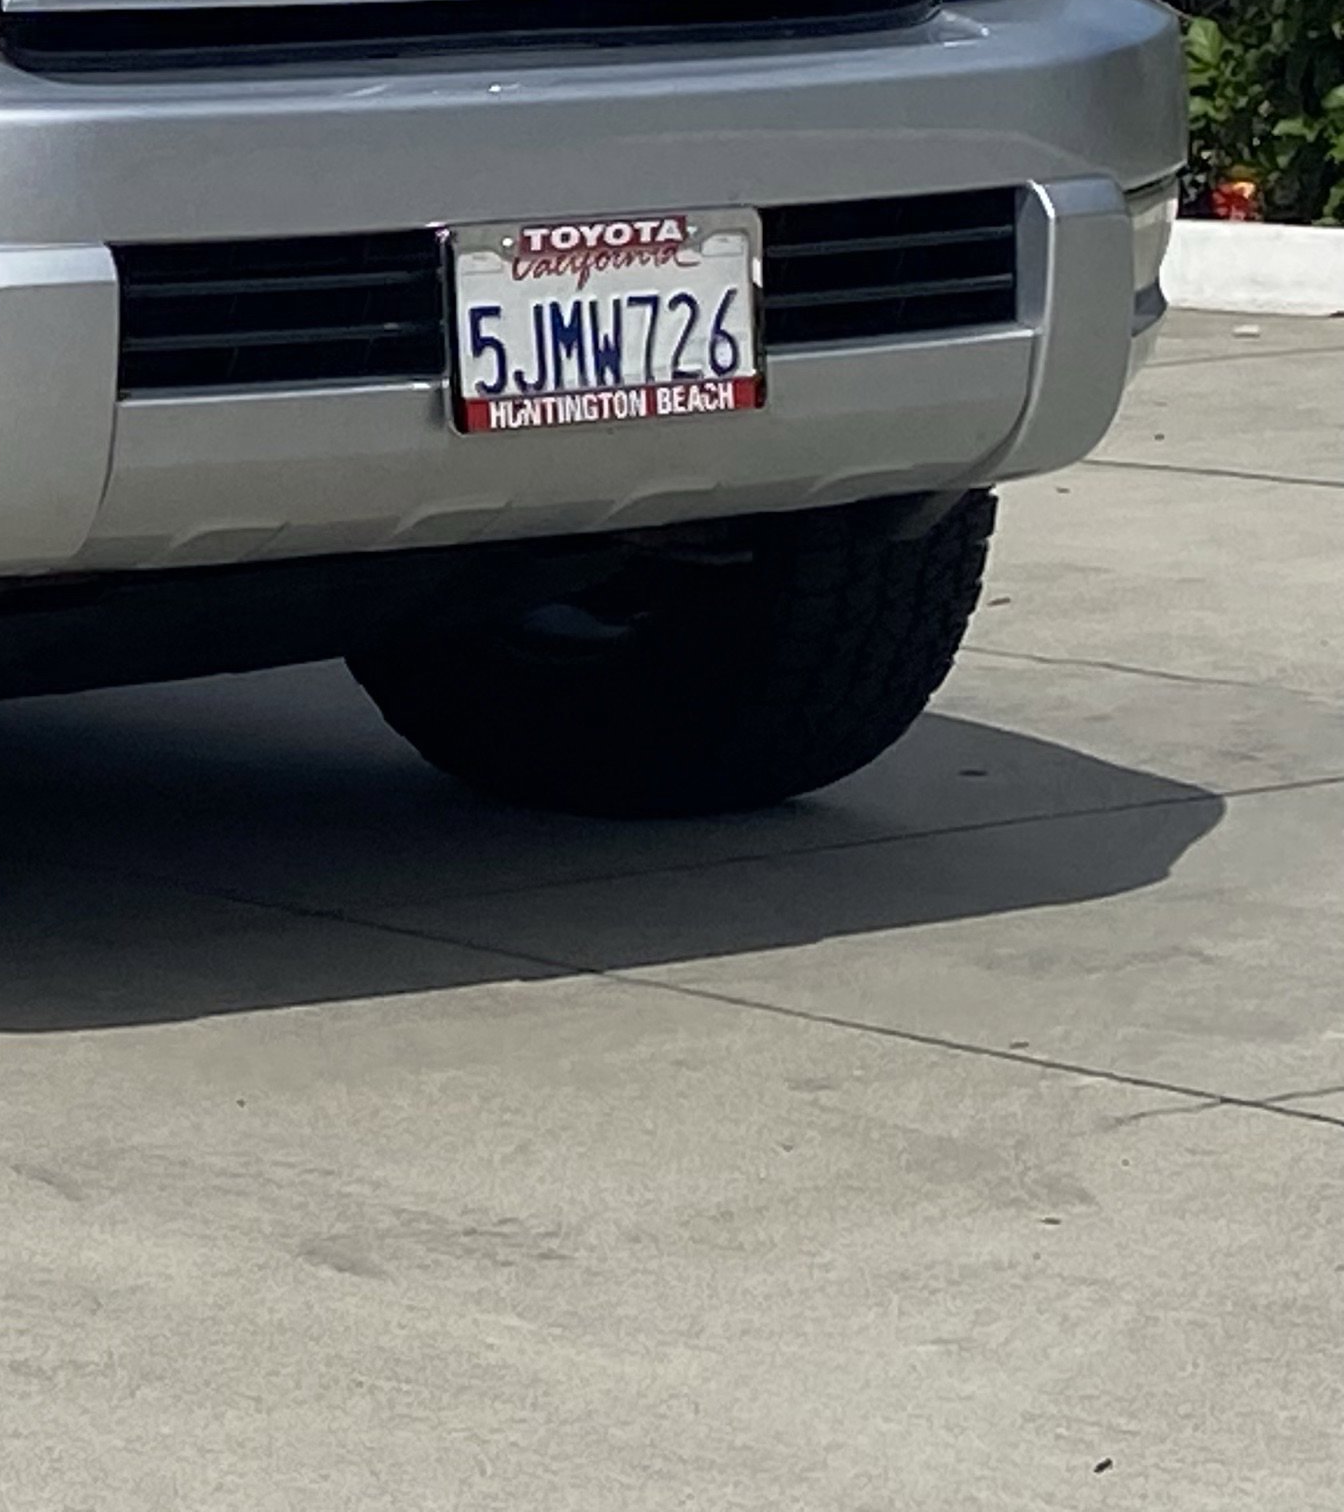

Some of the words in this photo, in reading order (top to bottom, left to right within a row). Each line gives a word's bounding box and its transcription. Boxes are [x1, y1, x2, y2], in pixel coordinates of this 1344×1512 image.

[522, 219, 685, 252] TOYOTA
[512, 244, 700, 290] California
[469, 288, 740, 395] 5JMW726
[489, 387, 648, 429] HUNTINGTON
[656, 381, 736, 416] BEACH
